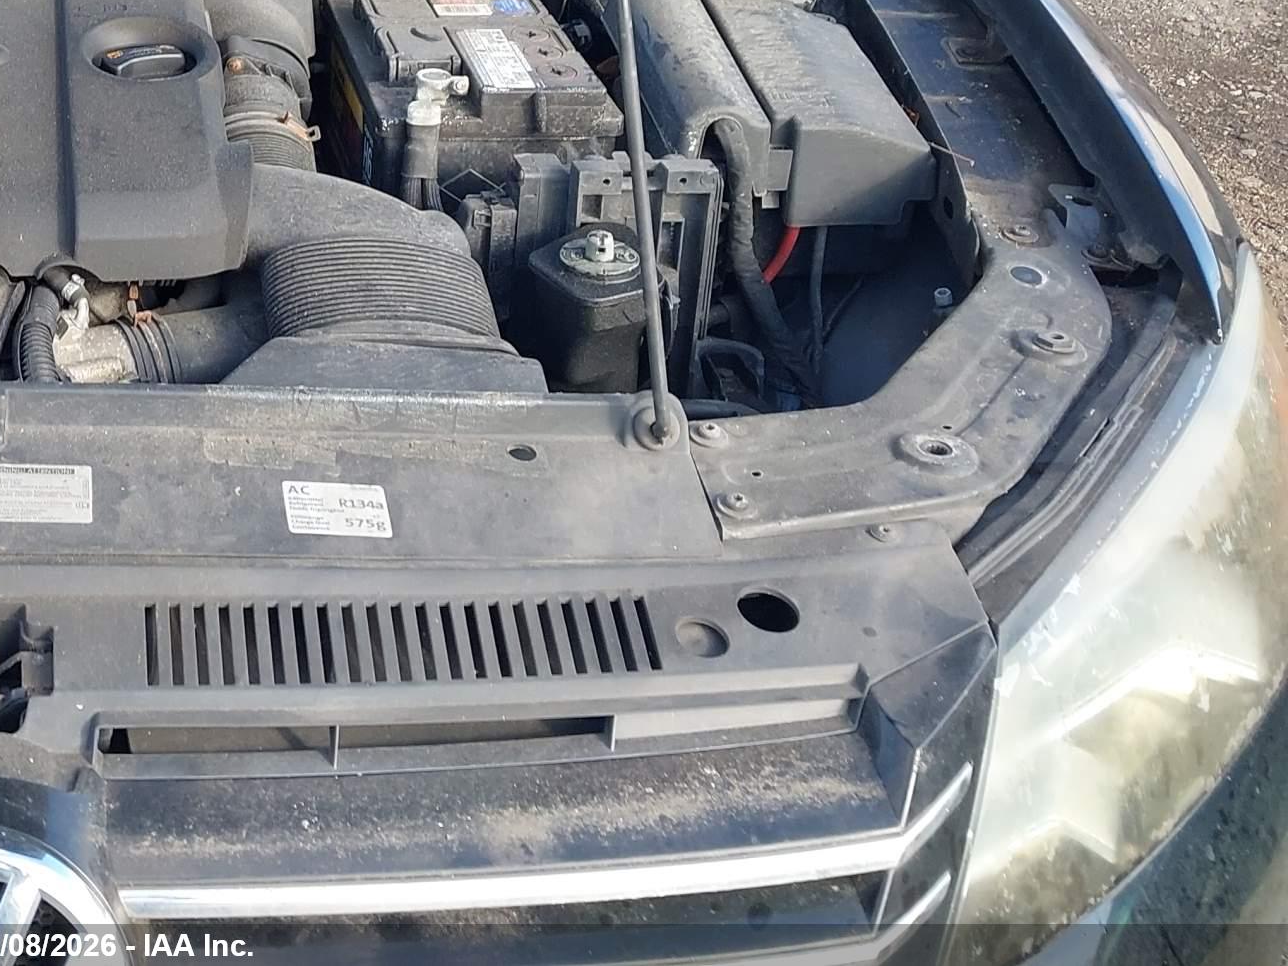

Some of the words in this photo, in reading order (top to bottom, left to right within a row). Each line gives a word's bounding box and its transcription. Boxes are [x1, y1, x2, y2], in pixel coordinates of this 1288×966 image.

[288, 485, 310, 495] AC
[338, 498, 384, 510] R134a
[345, 517, 387, 532] 575g
